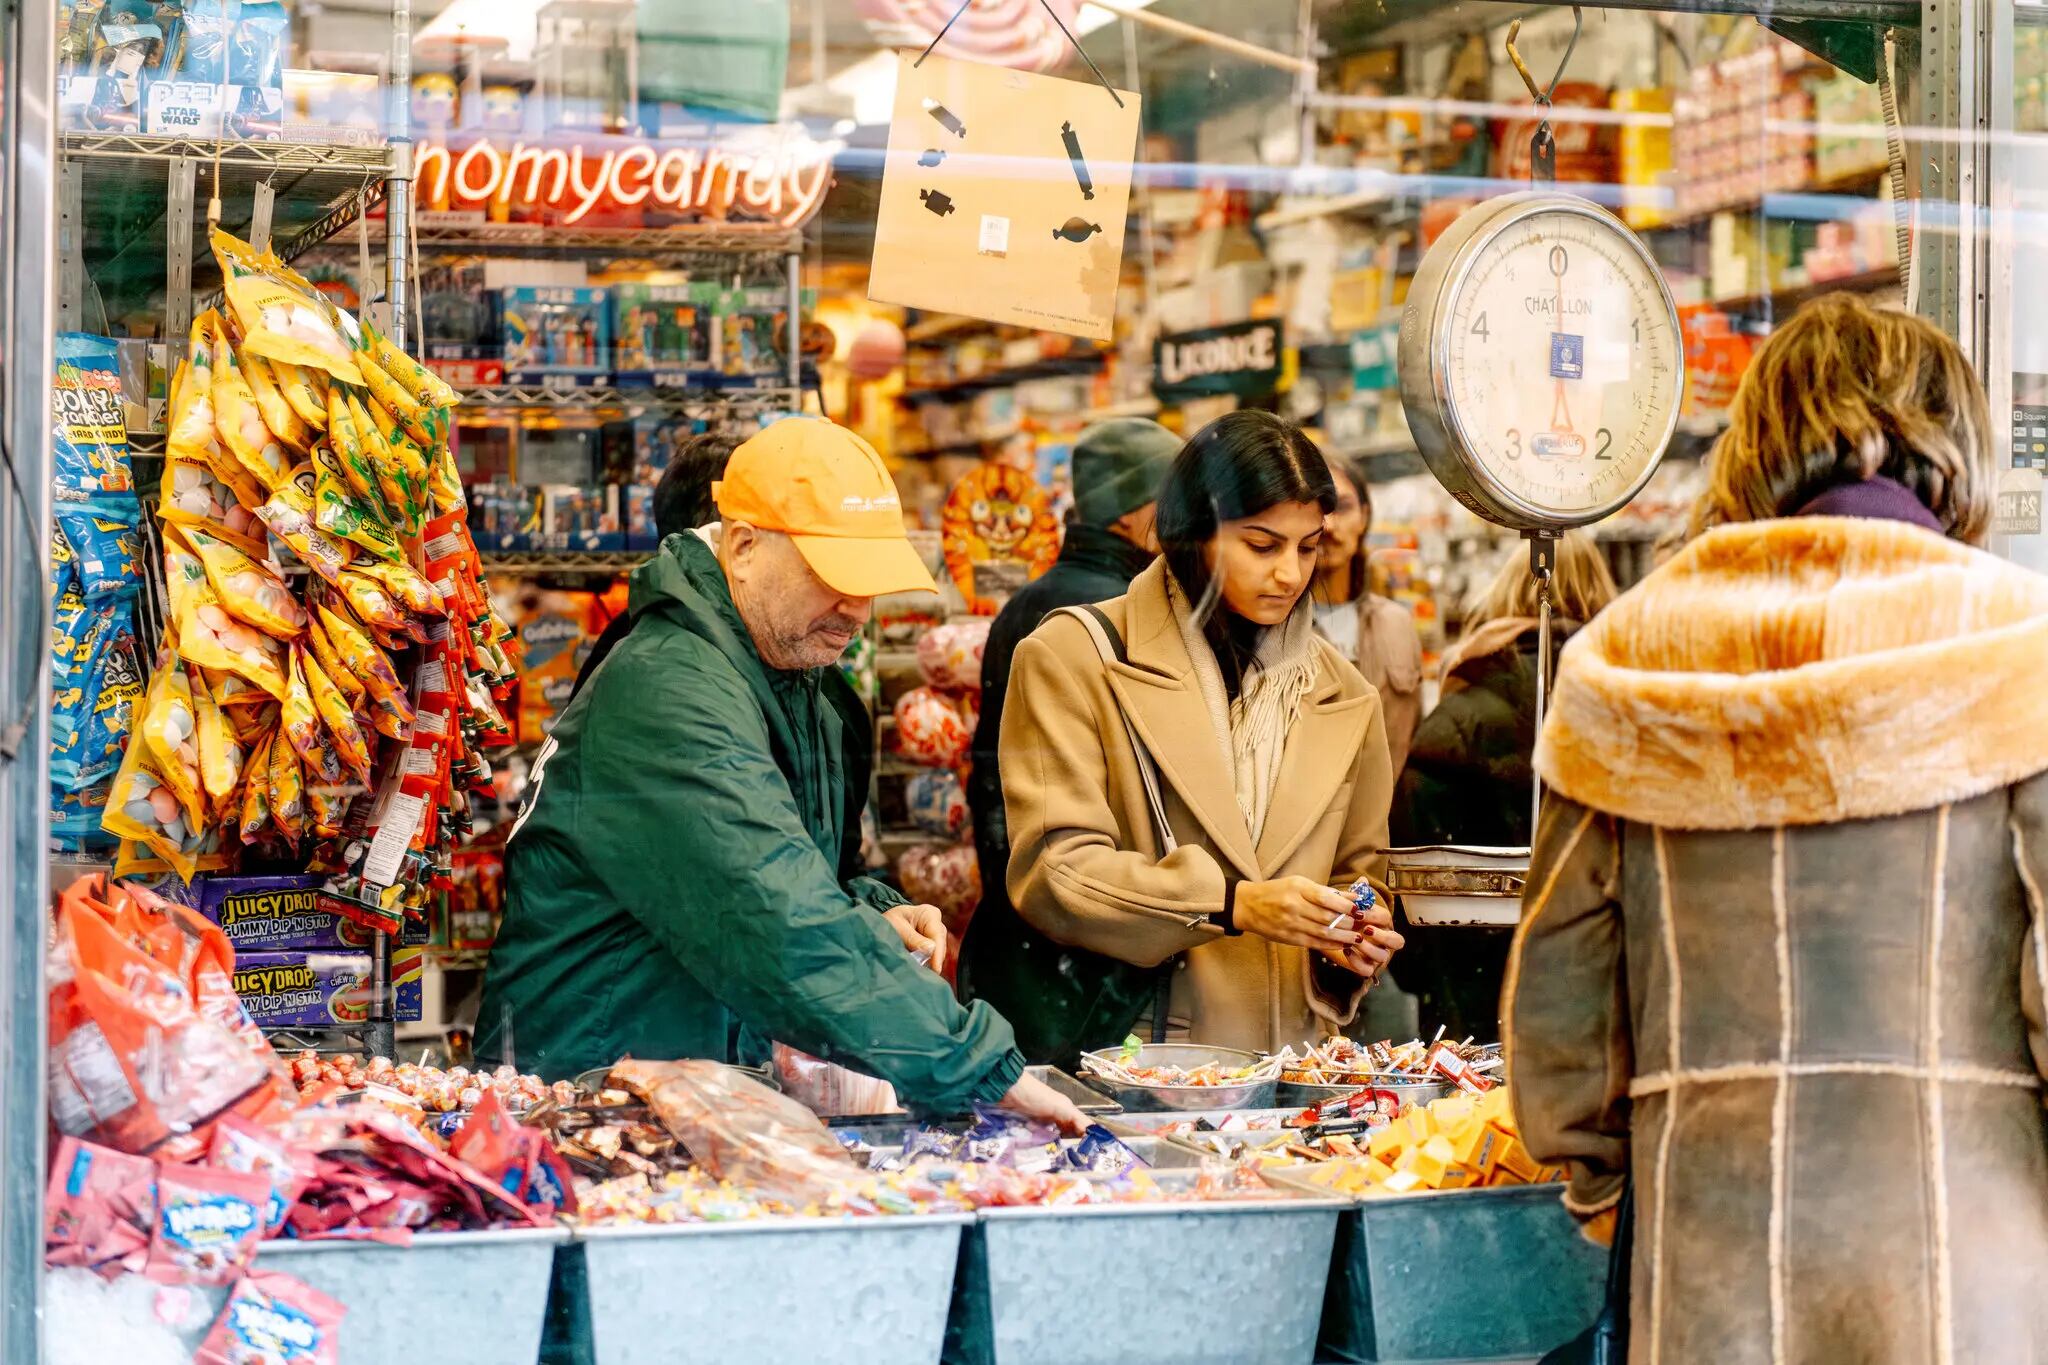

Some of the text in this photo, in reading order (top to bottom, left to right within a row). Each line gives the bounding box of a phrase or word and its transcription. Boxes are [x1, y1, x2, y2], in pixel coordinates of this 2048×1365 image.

[161, 107, 200, 116] STAR
[161, 115, 201, 126] WARS
[1548, 245, 1568, 277] 0
[1524, 294, 1593, 315] CHATILLON
[1471, 311, 1490, 343] 4
[1631, 316, 1640, 343] 1
[2023, 412, 2047, 422] Square
[1505, 428, 1522, 461] 3
[1594, 427, 1612, 460] 2
[226, 895, 282, 925] JUICY
[222, 921, 269, 938] GUMMY
[270, 919, 291, 934] DIP
[304, 914, 331, 929] STIX
[239, 937, 259, 945] CHEWY
[259, 935, 279, 943] STICKS
[275, 968, 314, 990] DROP
[330, 975, 348, 987] CHEW
[261, 995, 282, 1011] DIP
[296, 990, 321, 1006] STIX
[270, 1009, 282, 1017] AND
